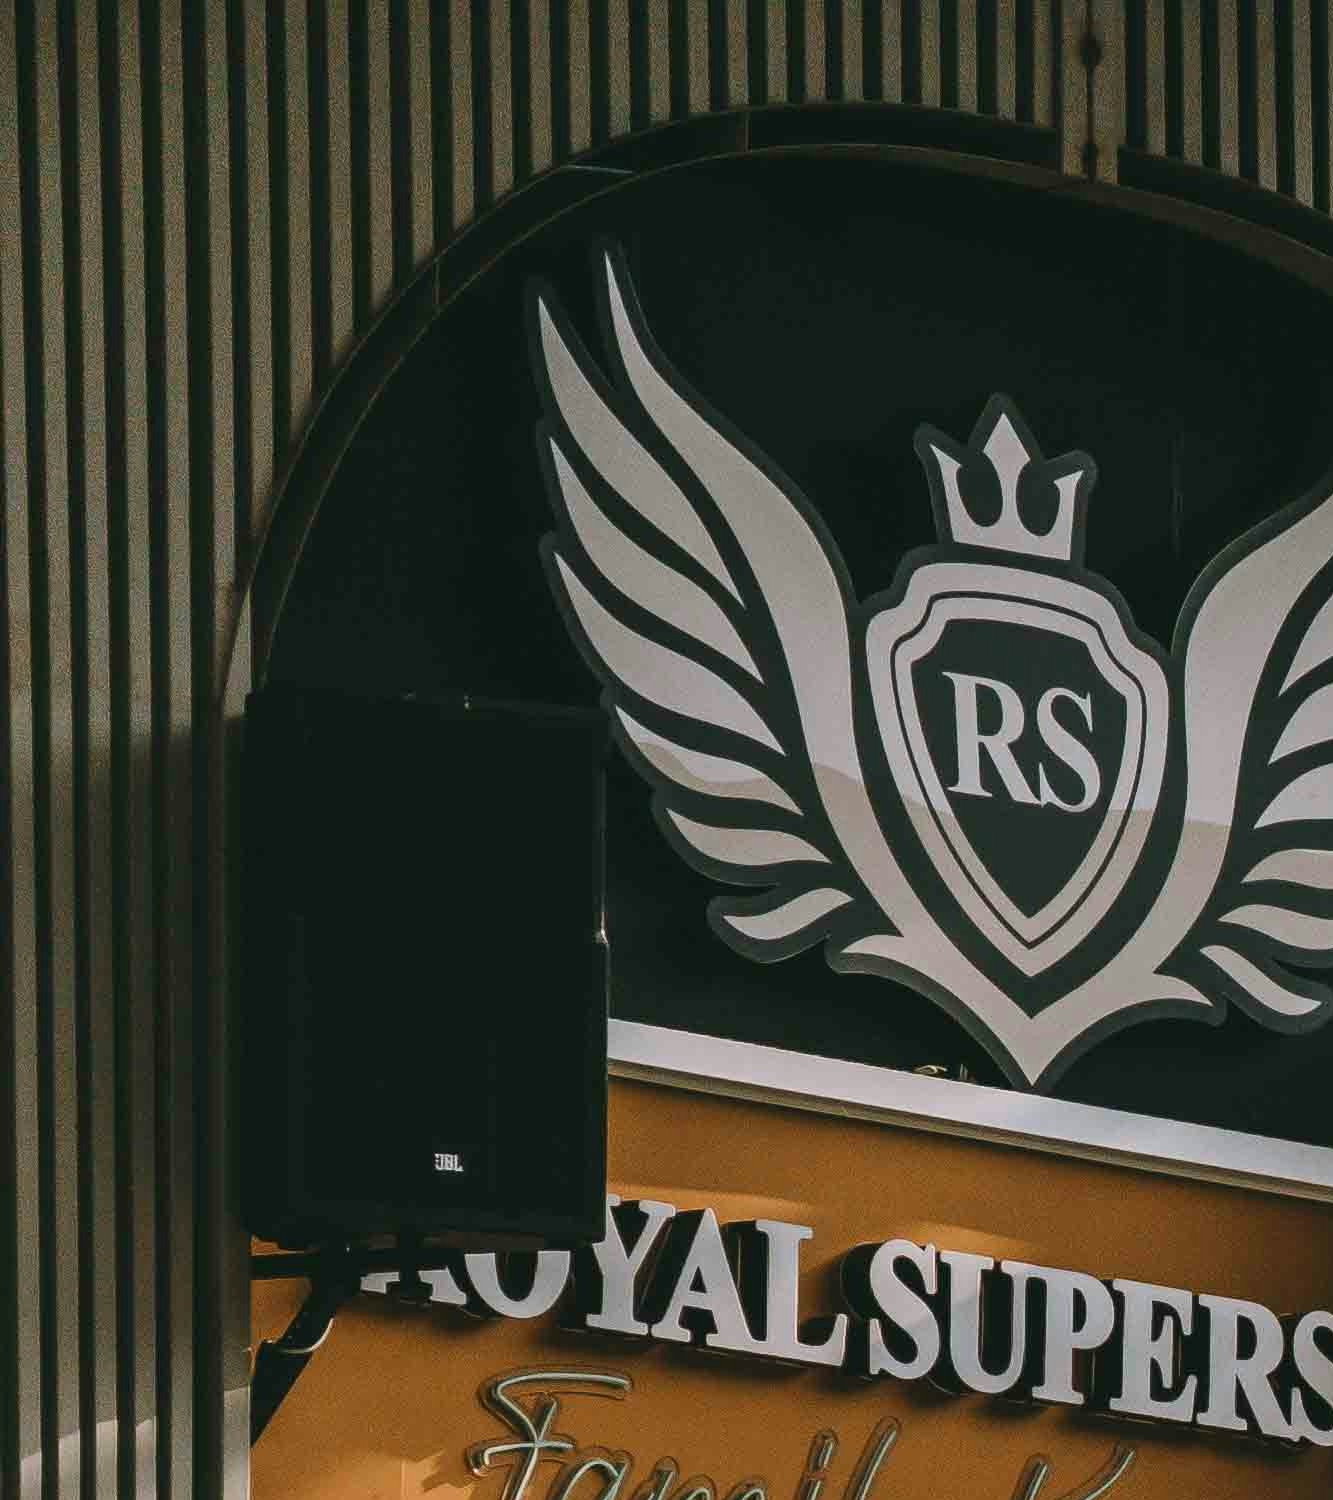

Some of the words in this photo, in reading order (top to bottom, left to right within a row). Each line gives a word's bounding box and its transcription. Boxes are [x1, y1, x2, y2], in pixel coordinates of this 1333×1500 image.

[942, 671, 1103, 812] RS
[434, 1153, 464, 1172] JBL
[360, 1193, 848, 1367] YAL
